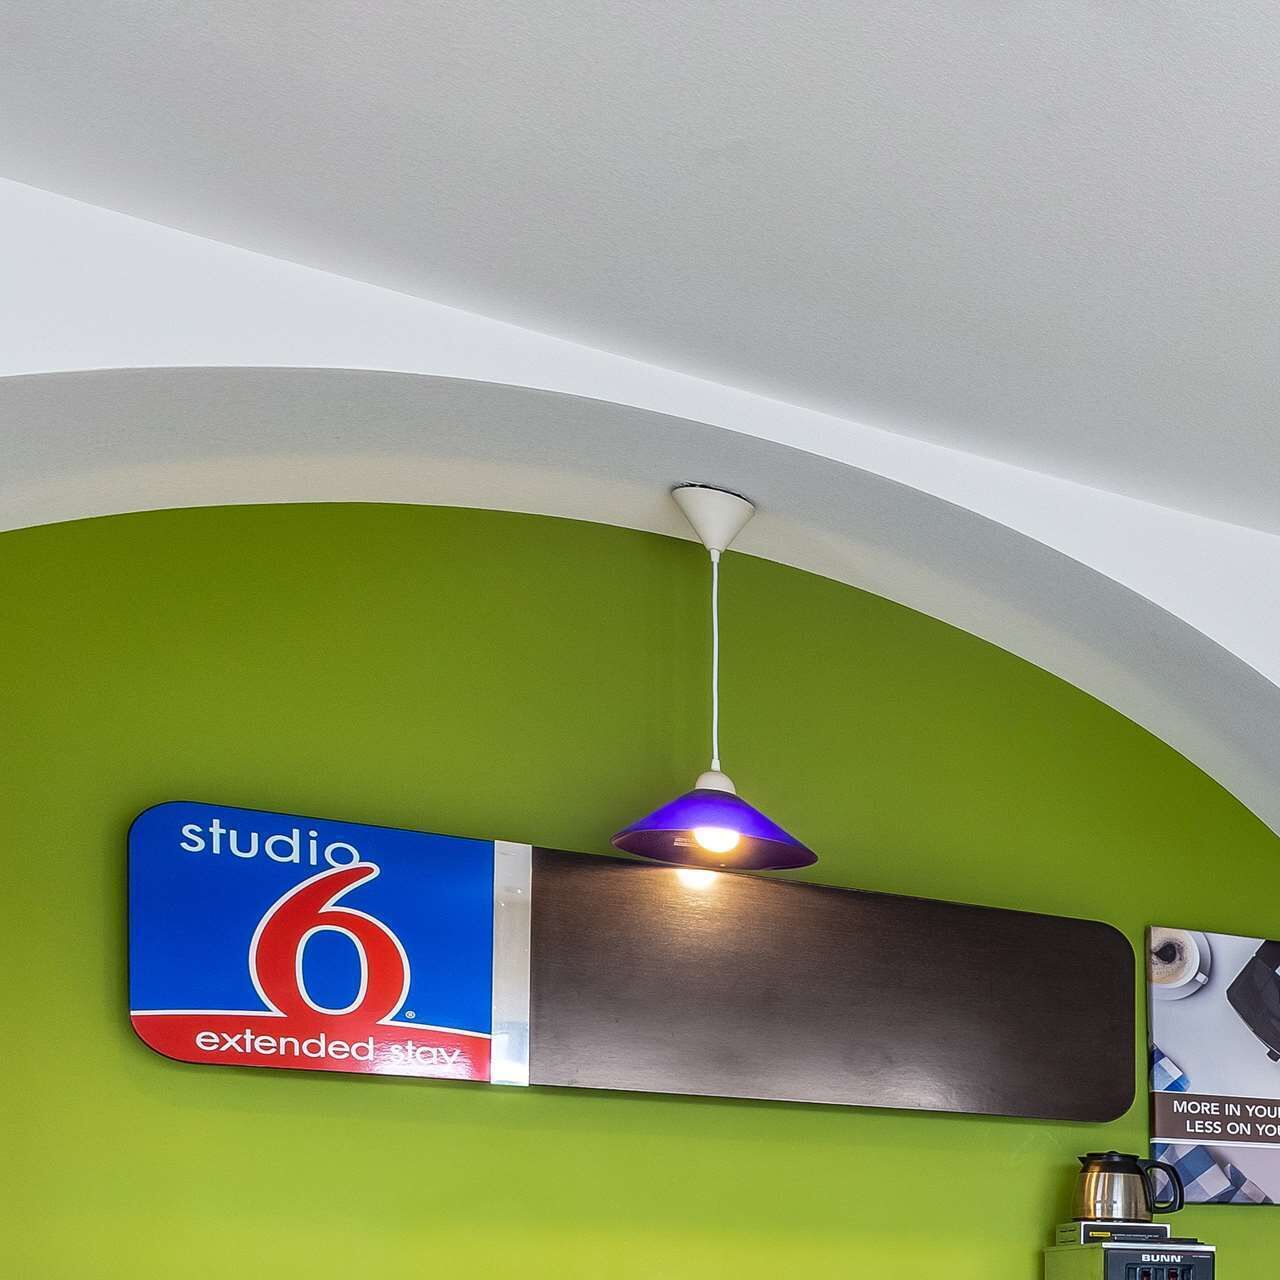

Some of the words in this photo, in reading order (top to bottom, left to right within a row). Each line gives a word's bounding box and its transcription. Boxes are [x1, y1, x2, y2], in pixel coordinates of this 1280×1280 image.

[180, 819, 360, 868] studio
[249, 862, 410, 1024] 6
[196, 1029, 374, 1060] extended
[391, 1040, 460, 1065] stay
[1173, 1100, 1220, 1115] MORE
[1225, 1103, 1241, 1117] IN
[1186, 1120, 1222, 1134] LESS
[1226, 1122, 1251, 1135] ON
[1141, 1254, 1182, 1263] BUNN
